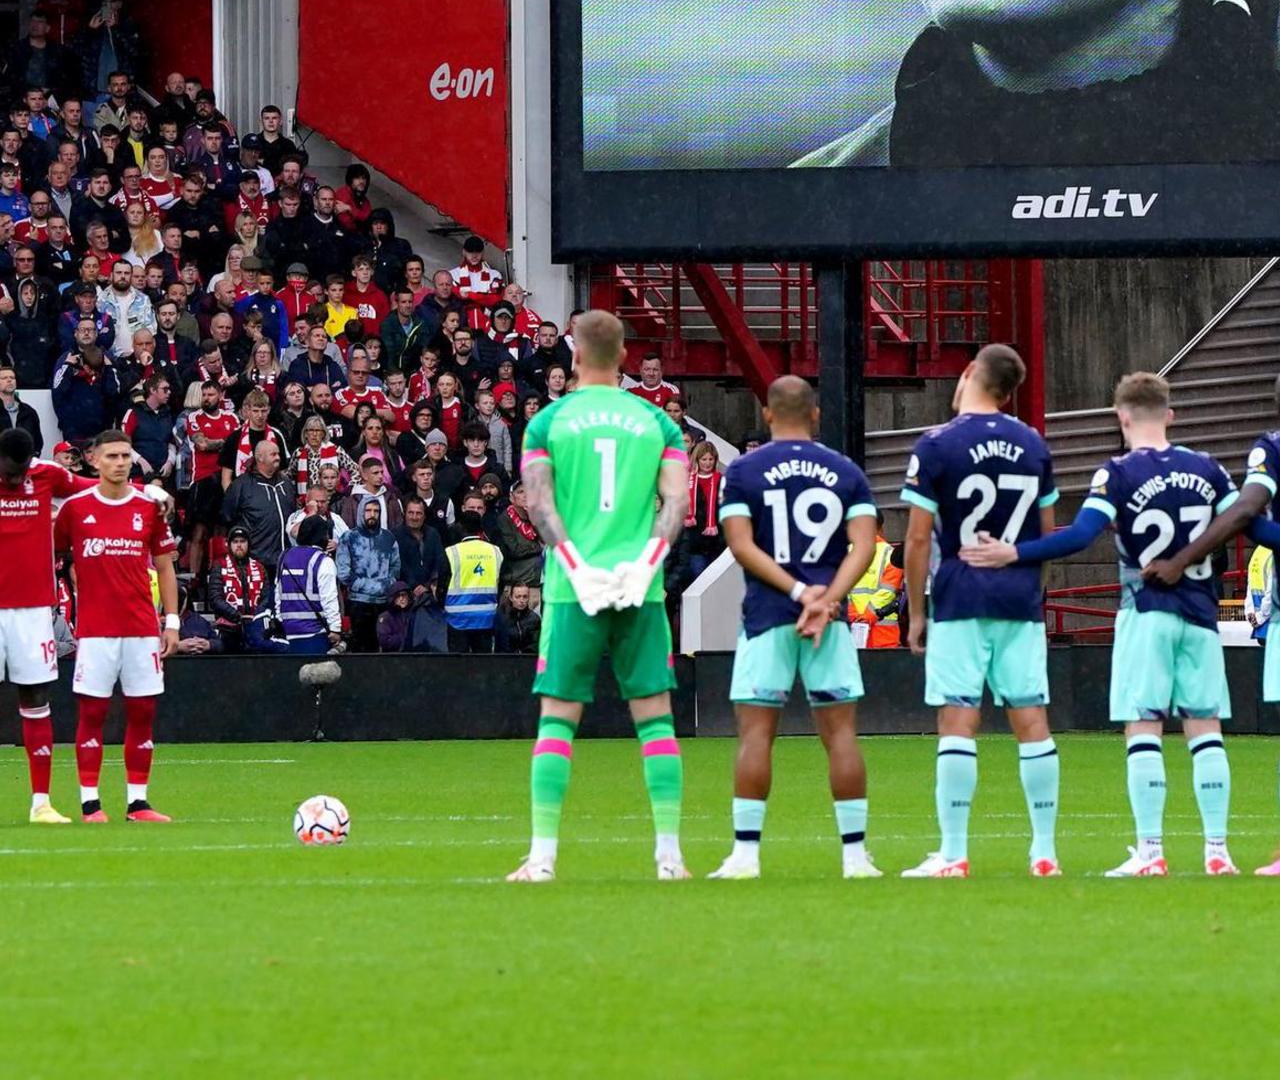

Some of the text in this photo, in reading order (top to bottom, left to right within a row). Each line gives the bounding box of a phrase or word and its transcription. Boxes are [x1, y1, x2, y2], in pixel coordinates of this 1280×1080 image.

[1011, 186, 1159, 220] adi.tv
[568, 410, 647, 437] FLEKKEN
[969, 440, 1025, 464] JANELT
[594, 438, 616, 512] 1
[764, 459, 839, 487] MBEUMO
[1126, 471, 1218, 513] LEWIS-POTTER
[763, 487, 844, 564] 19
[957, 474, 1040, 546] 27
[472, 561, 485, 576] 4
[40, 640, 56, 664] 19
